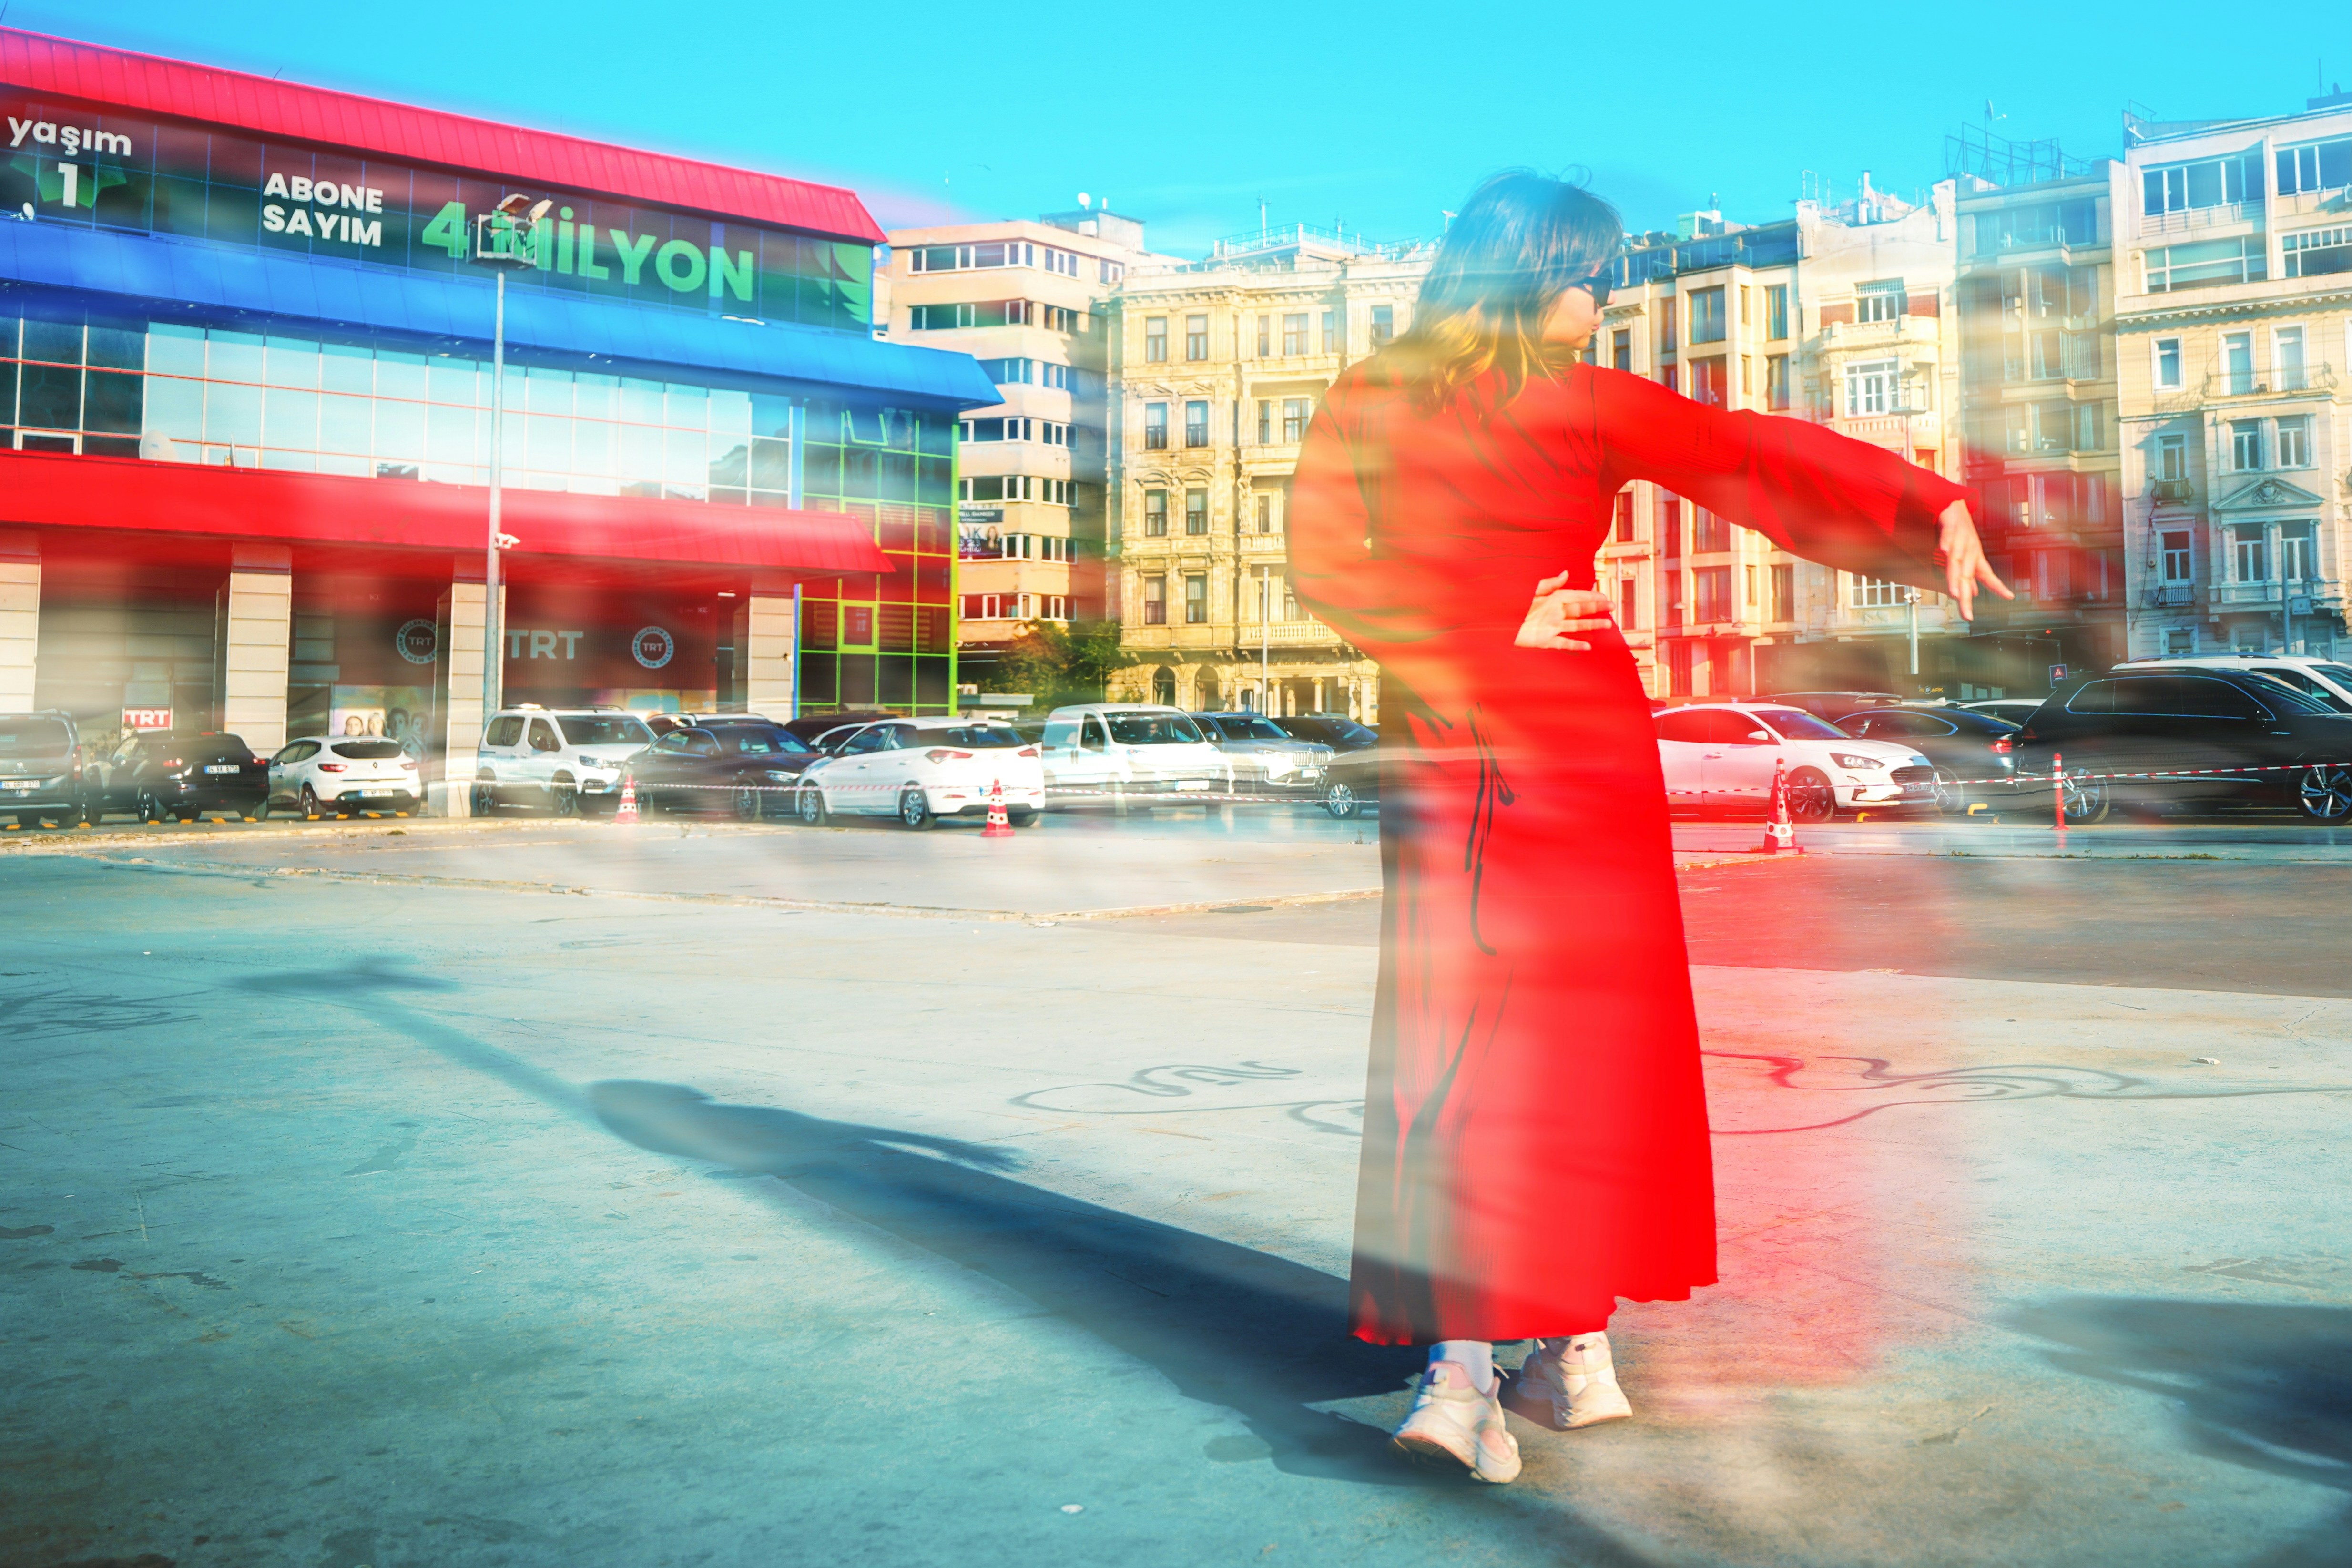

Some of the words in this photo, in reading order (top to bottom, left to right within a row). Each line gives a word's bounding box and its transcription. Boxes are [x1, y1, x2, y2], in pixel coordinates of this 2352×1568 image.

[7, 116, 132, 156] yaşım
[58, 163, 78, 208] 1
[263, 172, 383, 214] ABONE
[263, 204, 382, 247] SAYIM
[422, 201, 468, 259] 4
[408, 636, 432, 646] TRT
[506, 629, 583, 660] TRT
[642, 642, 663, 652] TRT
[125, 710, 169, 725] TRT
